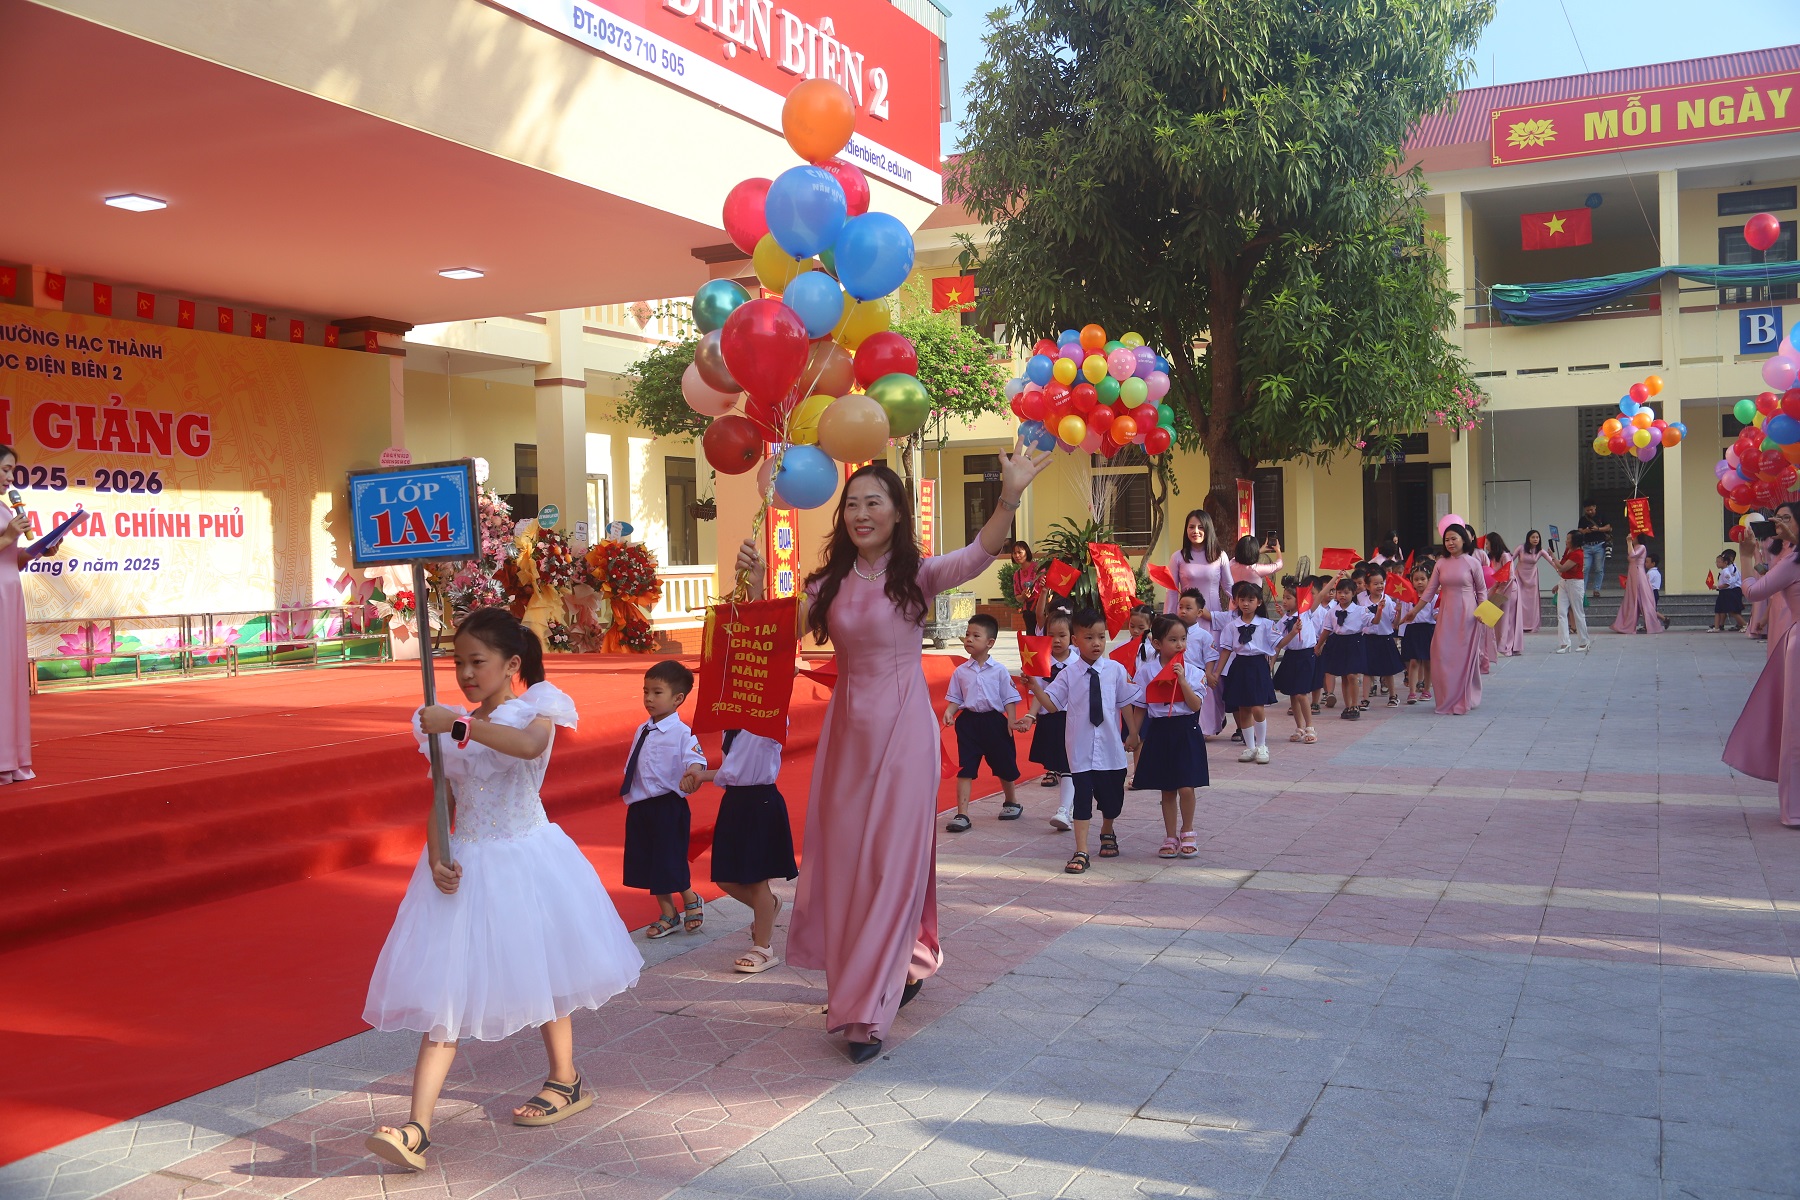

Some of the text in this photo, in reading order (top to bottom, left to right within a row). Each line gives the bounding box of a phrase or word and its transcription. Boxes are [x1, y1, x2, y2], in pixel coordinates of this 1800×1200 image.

[572, 5, 685, 77] ĐT:0373 710 505
[663, 0, 889, 121] IỆN BIÊN 2
[1584, 86, 1792, 142] MỖI NGÀY
[1747, 313, 1777, 346] B
[66, 333, 104, 355] HẠC
[107, 338, 163, 360] THÀNH
[25, 354, 66, 378] ĐIỆN
[72, 359, 108, 380] BIÊN
[112, 365, 123, 381] 2
[32, 395, 211, 458] GIẢNG
[13, 465, 68, 492] 025
[94, 469, 163, 495] 2026
[377, 479, 440, 505] LỚP
[115, 507, 190, 538] CHÍNH
[199, 506, 244, 539] PHỦ
[370, 505, 455, 549] 1A4
[24, 557, 160, 577] áng 9 năm 2025
[779, 571, 793, 596] HỌC
[730, 638, 773, 652] CHÀO
[734, 652, 768, 665] ĐÓN
[731, 665, 768, 679] NĂM
[732, 678, 764, 691] HỌC
[711, 702, 742, 713] 2025
[732, 691, 763, 705] MỚI
